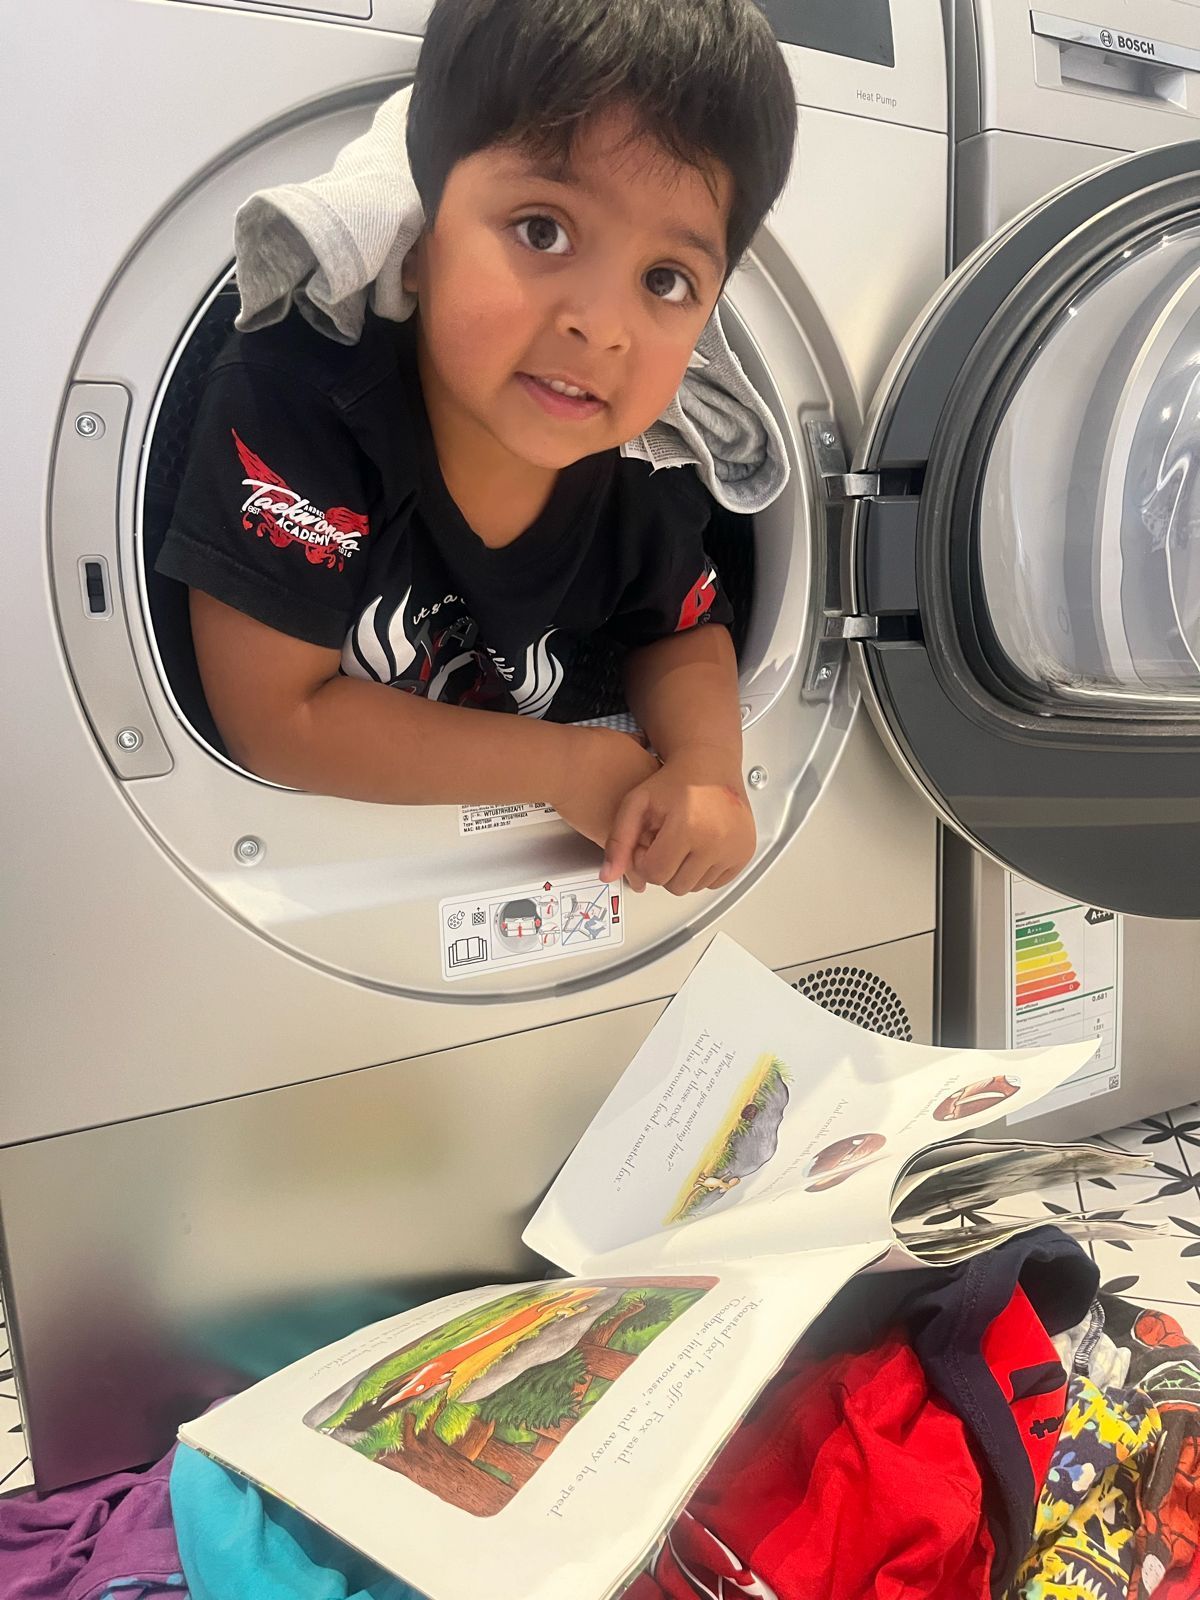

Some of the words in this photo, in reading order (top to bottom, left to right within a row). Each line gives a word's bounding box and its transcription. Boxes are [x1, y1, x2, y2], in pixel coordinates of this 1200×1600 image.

[1118, 36, 1155, 55] BOSCH
[856, 90, 874, 103] Heat
[876, 94, 897, 108] Pump
[242, 479, 362, 551] Taekwondo
[276, 517, 331, 546] ACADEMY
[694, 1028, 710, 1051] And
[685, 1048, 701, 1062] his
[662, 1063, 691, 1101] favourite
[693, 1067, 708, 1079] by
[705, 1077, 715, 1092] are
[680, 1079, 699, 1103] these
[696, 1090, 708, 1109] you
[649, 1102, 668, 1126] food
[663, 1103, 682, 1128] rocks,
[676, 1109, 698, 1142] meeting
[643, 1123, 654, 1133] is
[624, 1133, 646, 1169] roasted
[677, 1338, 703, 1360] little
[702, 1336, 725, 1360] fox!
[616, 1406, 638, 1432] and
[638, 1410, 664, 1433] Fox
[591, 1431, 617, 1463] away
[613, 1436, 639, 1464] said.
[575, 1465, 597, 1482] he
[546, 1484, 575, 1518] sped.
